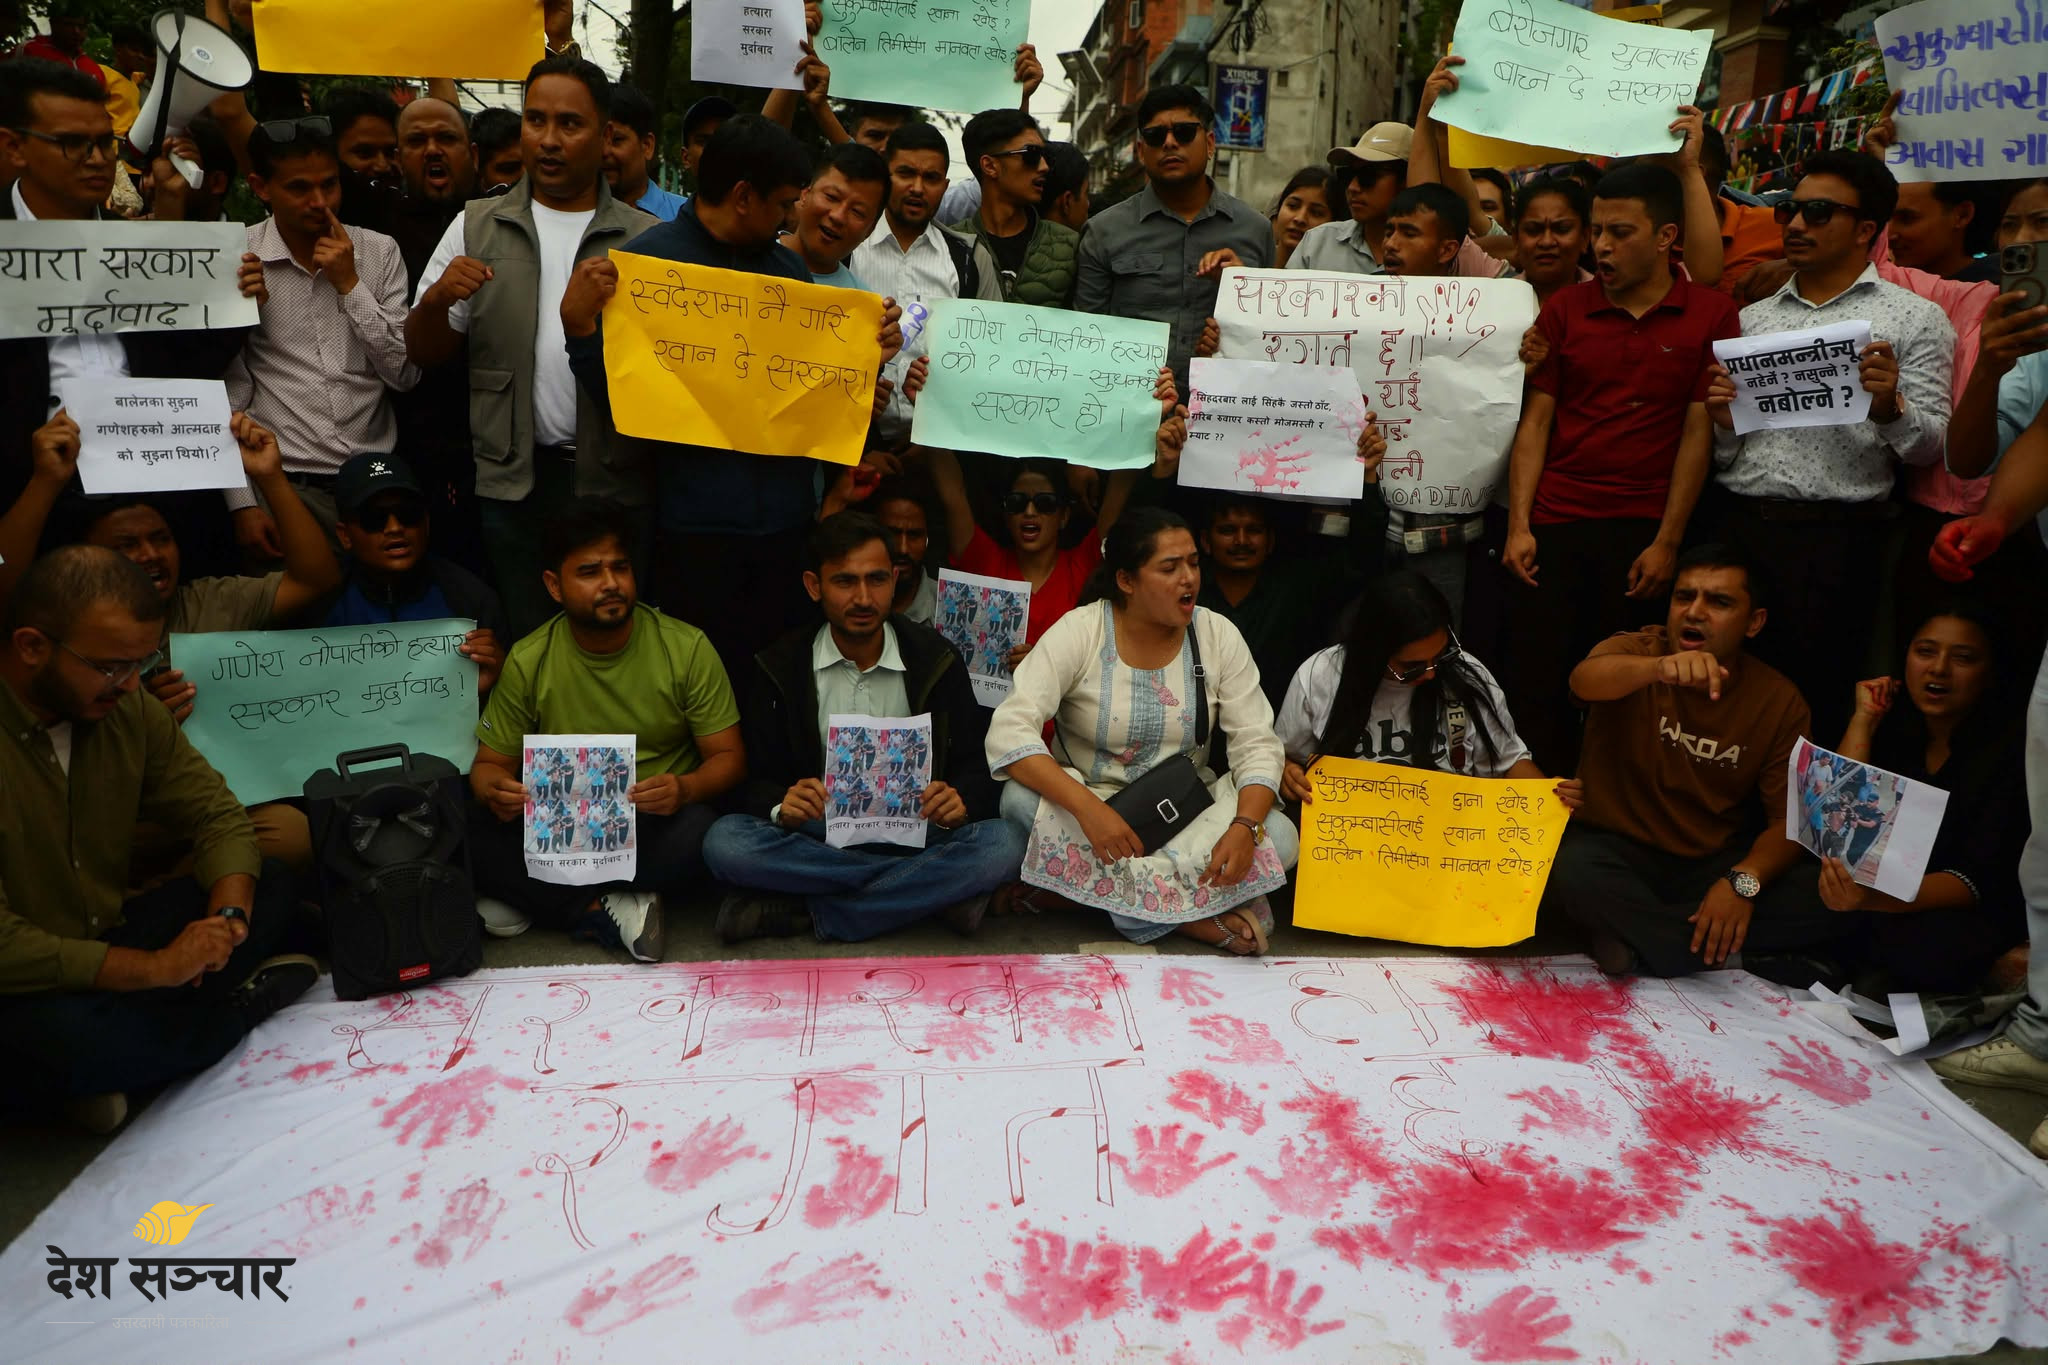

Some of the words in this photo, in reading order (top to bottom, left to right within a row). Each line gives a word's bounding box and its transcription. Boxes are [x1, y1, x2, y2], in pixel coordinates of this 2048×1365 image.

[743, 6, 773, 18] हत्यारा
[927, 8, 960, 23] खाना
[742, 25, 773, 37] सरकार
[822, 27, 866, 54] बालेन
[935, 40, 981, 60] मानवता
[740, 41, 773, 55] मुर्दावाद
[1611, 43, 1699, 71] युवालाई
[1559, 65, 1593, 100] दे
[1608, 79, 1694, 106] सरकार
[0, 247, 87, 281] यारा
[100, 247, 220, 280] सरकार
[758, 284, 790, 322] नै
[1233, 275, 1408, 317] सरकारको
[948, 306, 1006, 344] गणेश
[1019, 314, 1106, 353] नेपालीको
[654, 340, 716, 372] खान
[734, 333, 756, 378] दे
[941, 341, 976, 373] को
[1013, 353, 1068, 383] बालेन
[115, 394, 164, 408] बालेनका
[167, 397, 198, 413] सुइना
[1196, 391, 1237, 405] सिंहदरबार
[1241, 396, 1257, 407] लाई
[1290, 397, 1313, 409] जस्तो
[1754, 382, 1834, 413] नबोल्ने
[971, 391, 1065, 429] सरकार
[1075, 393, 1107, 434] हो
[1192, 411, 1212, 422] गरिब
[1247, 416, 1270, 426] कस्तो
[1274, 417, 1314, 429] मोजमस्ती
[96, 421, 164, 436] गणेशहरुको
[171, 423, 221, 435] आत्मदाह
[117, 448, 133, 461] को
[141, 449, 173, 466] सुइना
[211, 641, 285, 681] गणेश
[407, 634, 472, 660] हत्यार
[229, 690, 350, 730] सरकार
[361, 672, 450, 714] मुर्दावाद
[855, 821, 880, 830] सरकार
[1443, 826, 1486, 847] खाना
[559, 858, 588, 867] सरकार
[1312, 840, 1363, 864] बालेन
[1440, 857, 1490, 876] मानवता
